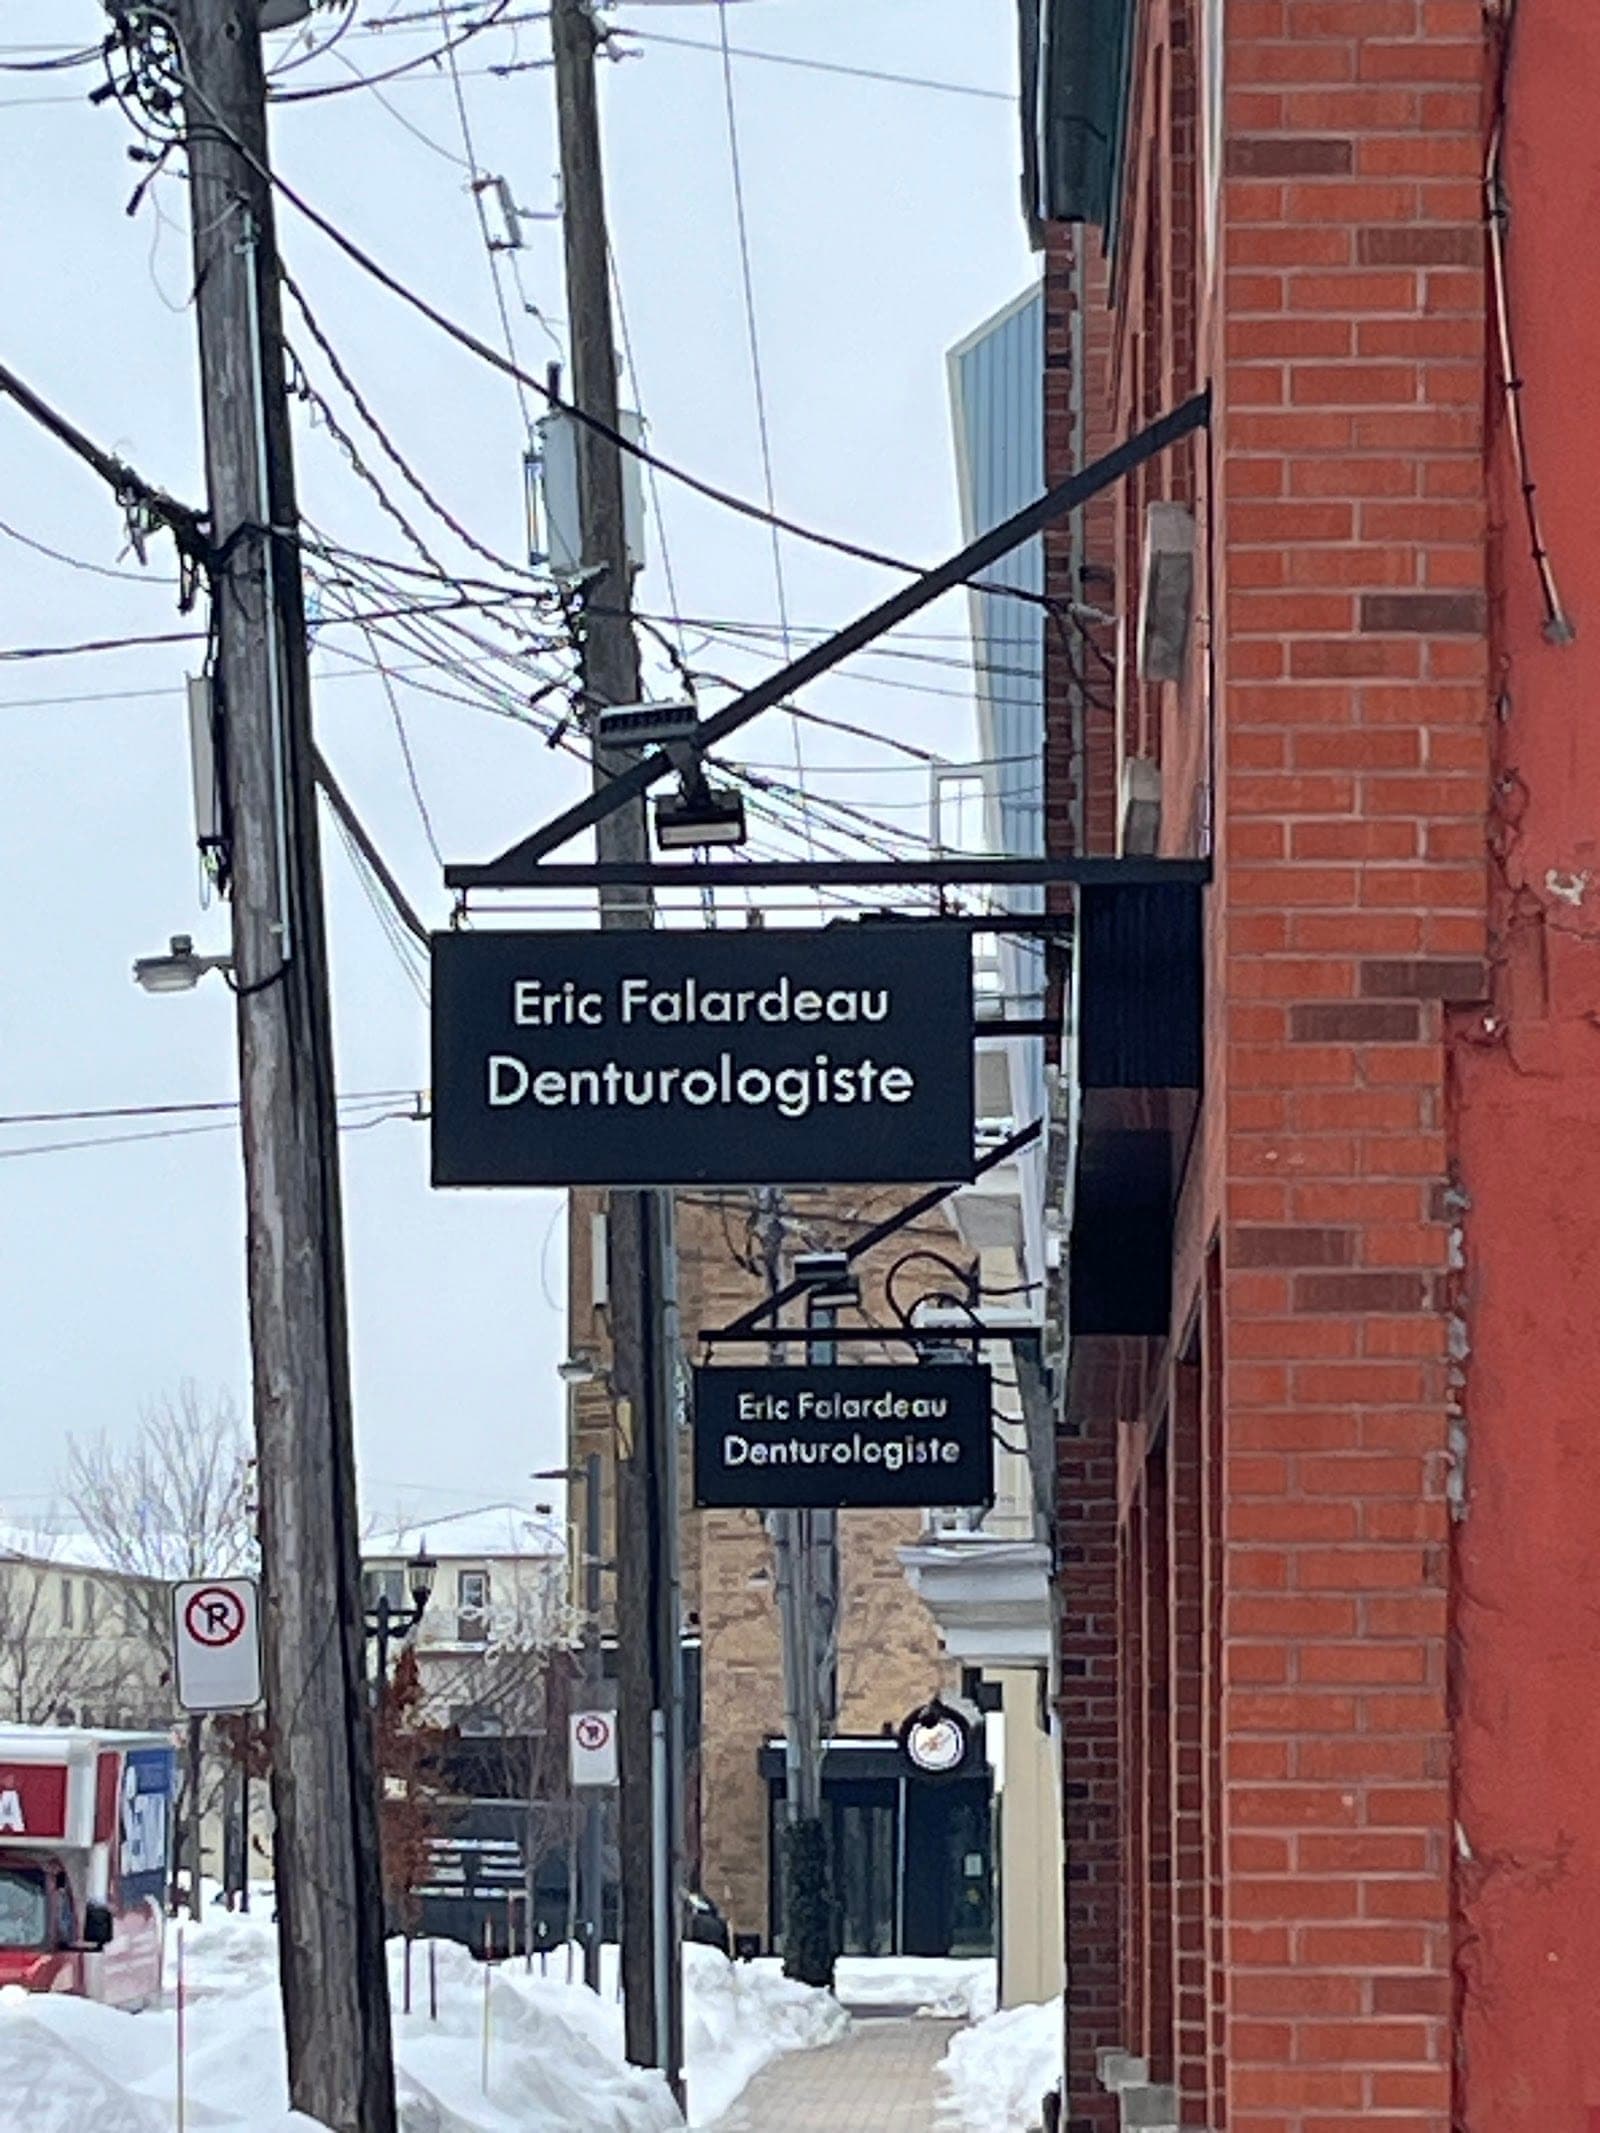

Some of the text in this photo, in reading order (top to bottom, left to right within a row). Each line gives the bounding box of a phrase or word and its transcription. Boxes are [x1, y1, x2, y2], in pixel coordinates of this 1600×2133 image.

[514, 976, 888, 1025] Eric Falardeau
[488, 1052, 914, 1117] Denturologiste
[738, 1391, 947, 1421] Eric Falardeau
[724, 1433, 960, 1470] Denturologiste
